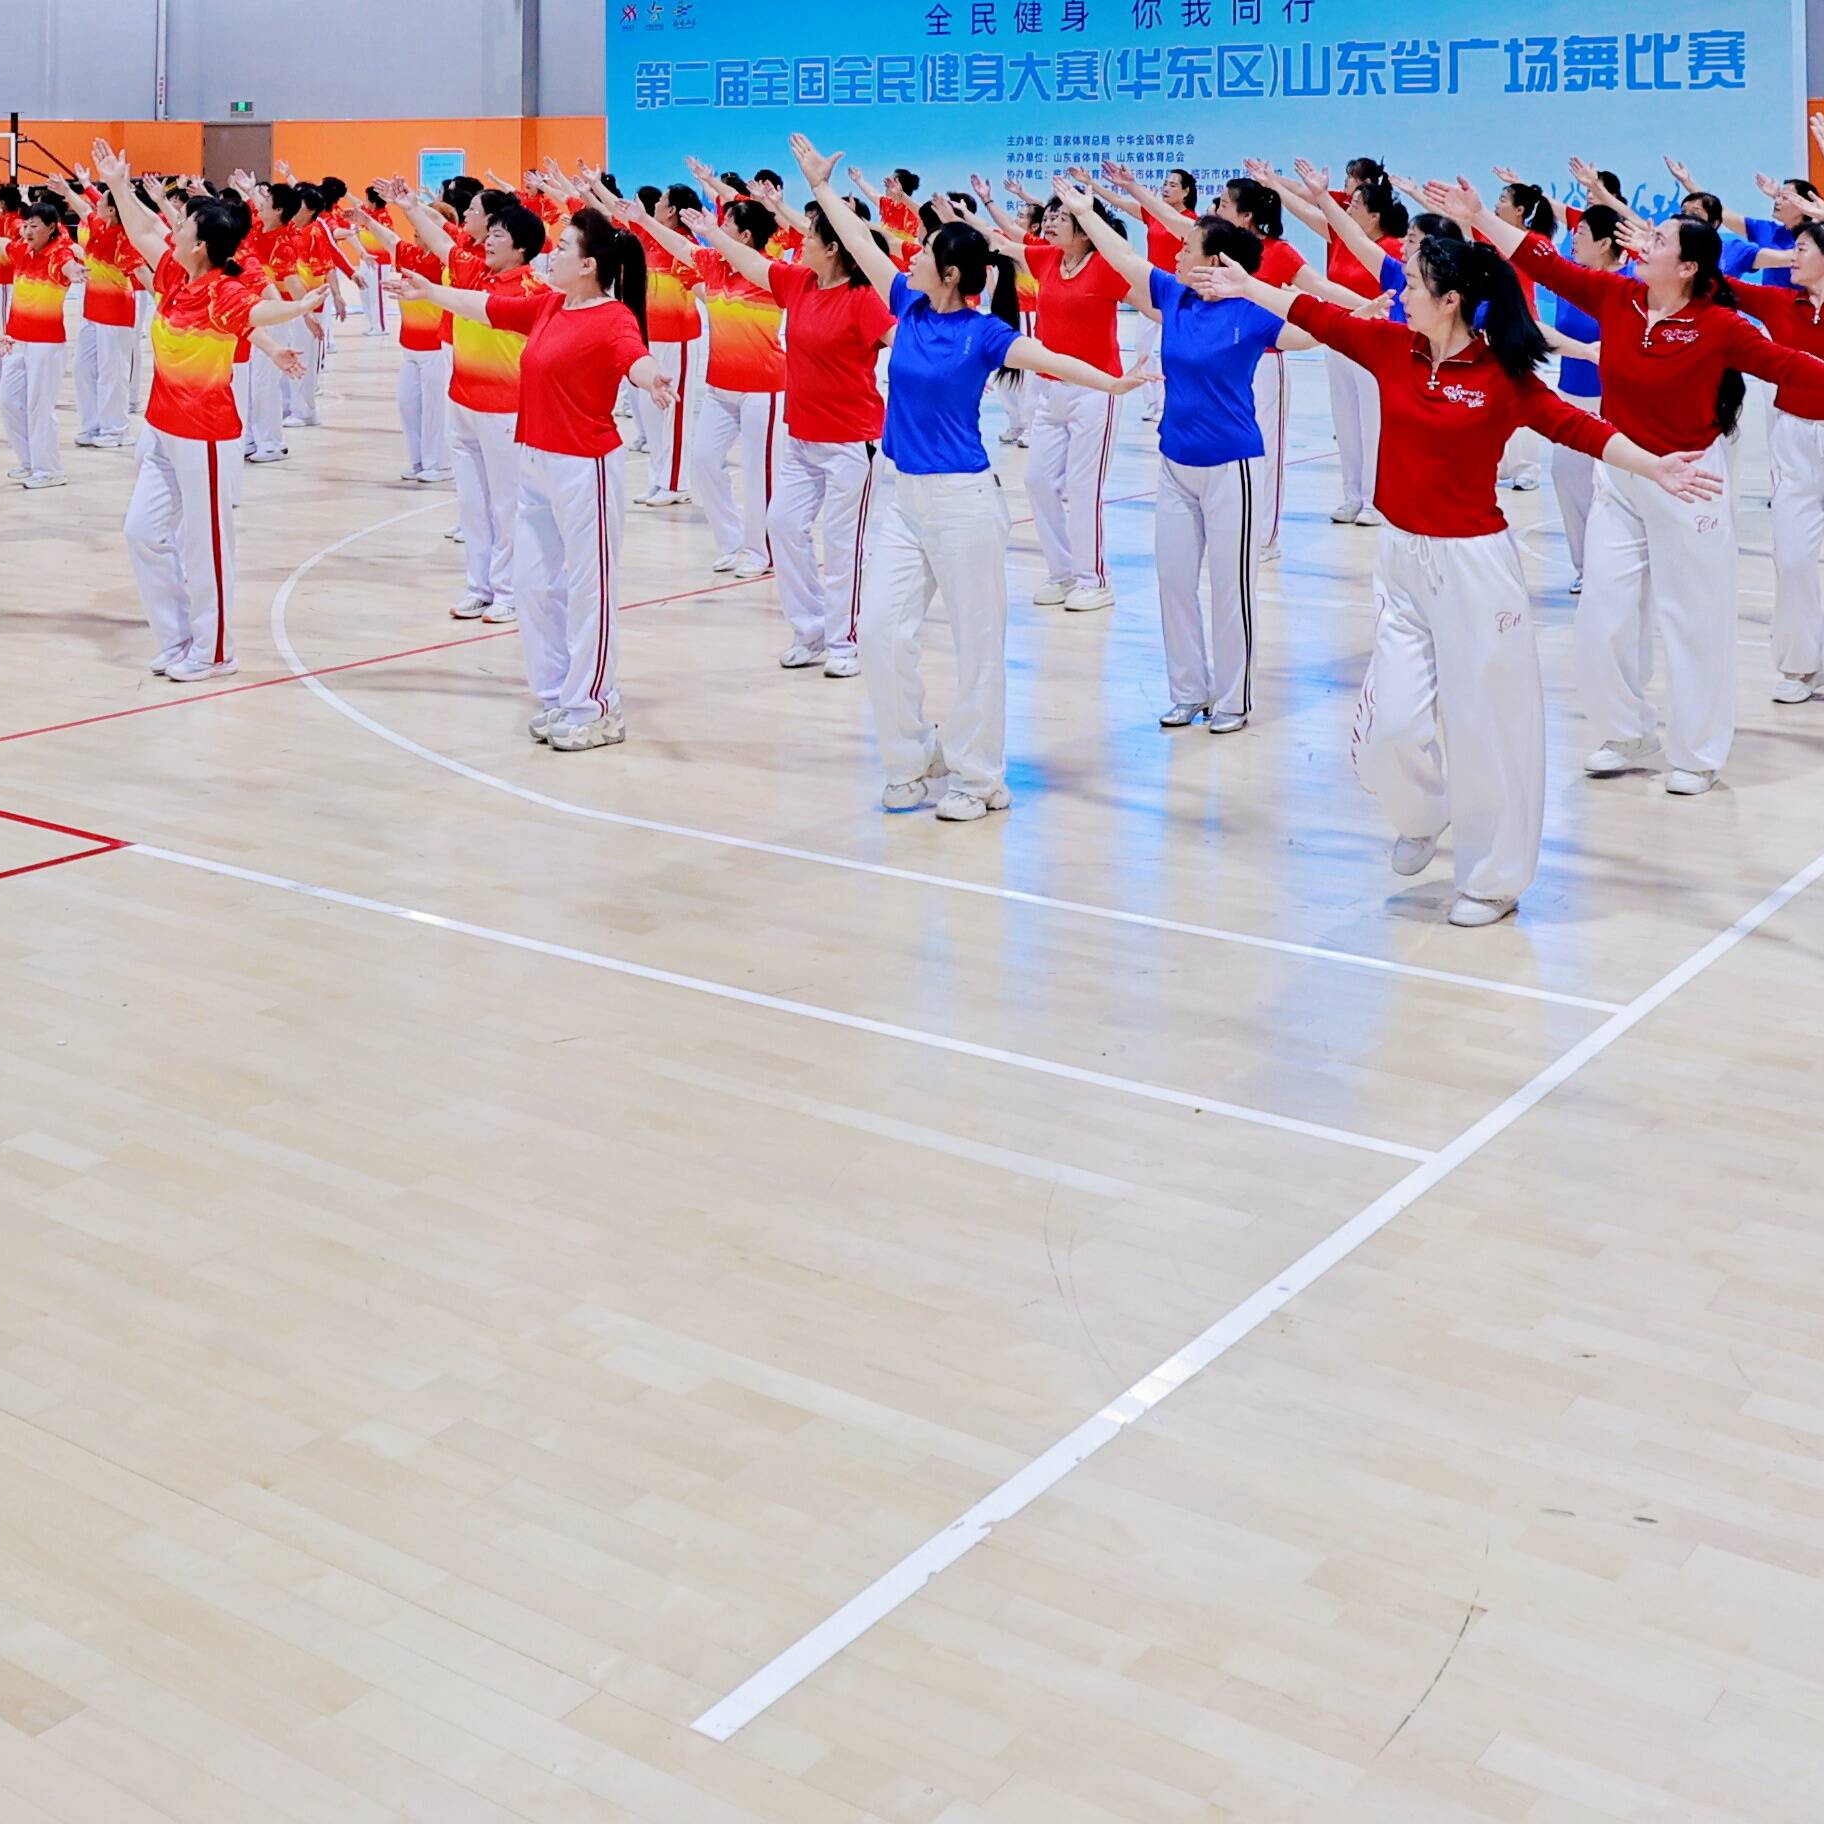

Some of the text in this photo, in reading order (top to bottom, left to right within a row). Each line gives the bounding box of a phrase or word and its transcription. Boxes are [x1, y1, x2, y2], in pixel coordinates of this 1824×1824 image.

[635, 29, 1747, 110] 第二届全国全民健身大赛(华东区)山东省广场舞比赛
